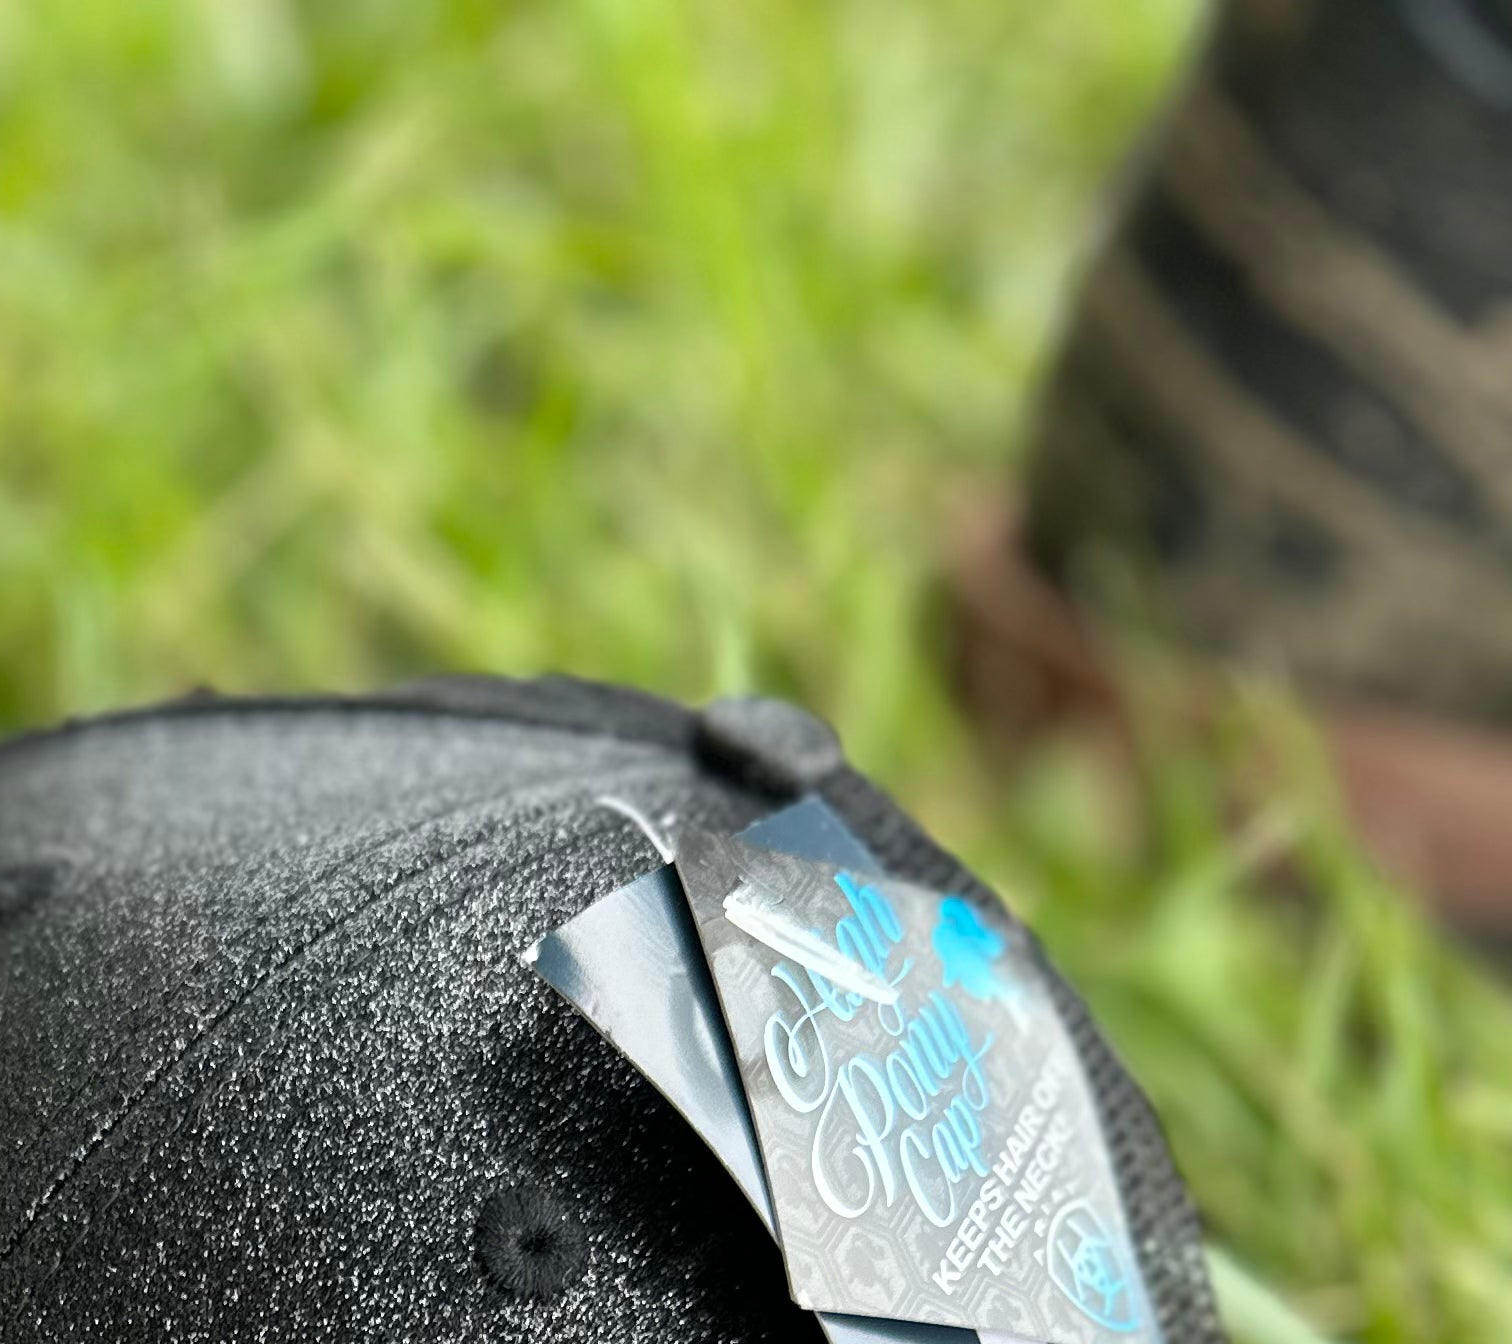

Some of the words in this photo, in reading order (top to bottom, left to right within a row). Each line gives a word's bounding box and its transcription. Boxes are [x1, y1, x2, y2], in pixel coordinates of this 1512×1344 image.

[812, 991, 995, 1219] Pony
[899, 1096, 989, 1228] Cap
[931, 1179, 1007, 1296] KEEPS
[992, 1104, 1041, 1187] HAIR
[976, 1203, 1031, 1277] THE
